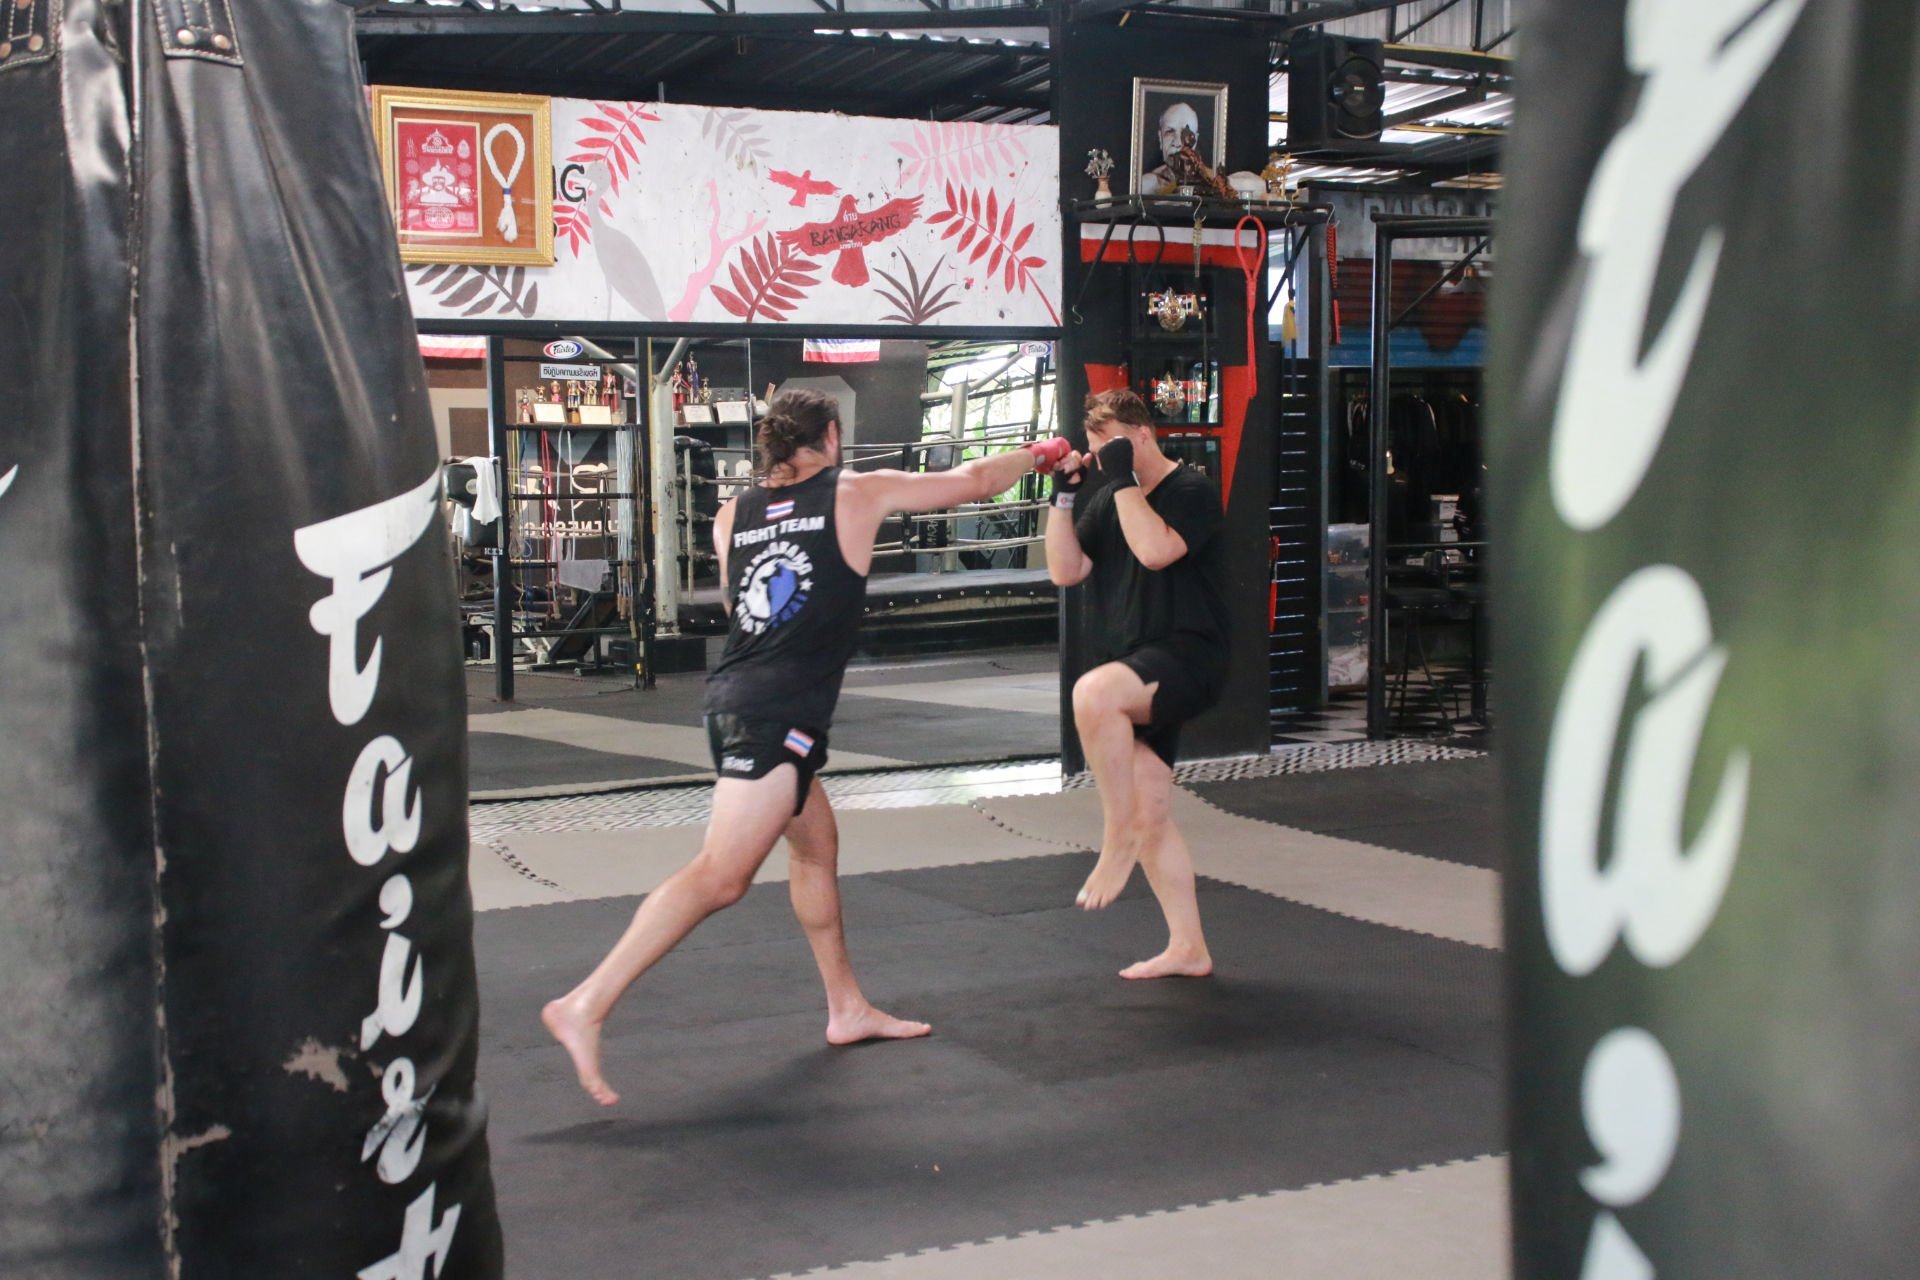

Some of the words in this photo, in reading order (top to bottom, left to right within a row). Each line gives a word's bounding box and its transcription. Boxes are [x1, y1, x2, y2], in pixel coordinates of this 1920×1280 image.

[552, 164, 586, 202] G
[734, 525, 778, 548] FIGHT
[780, 516, 825, 534] TEAM
